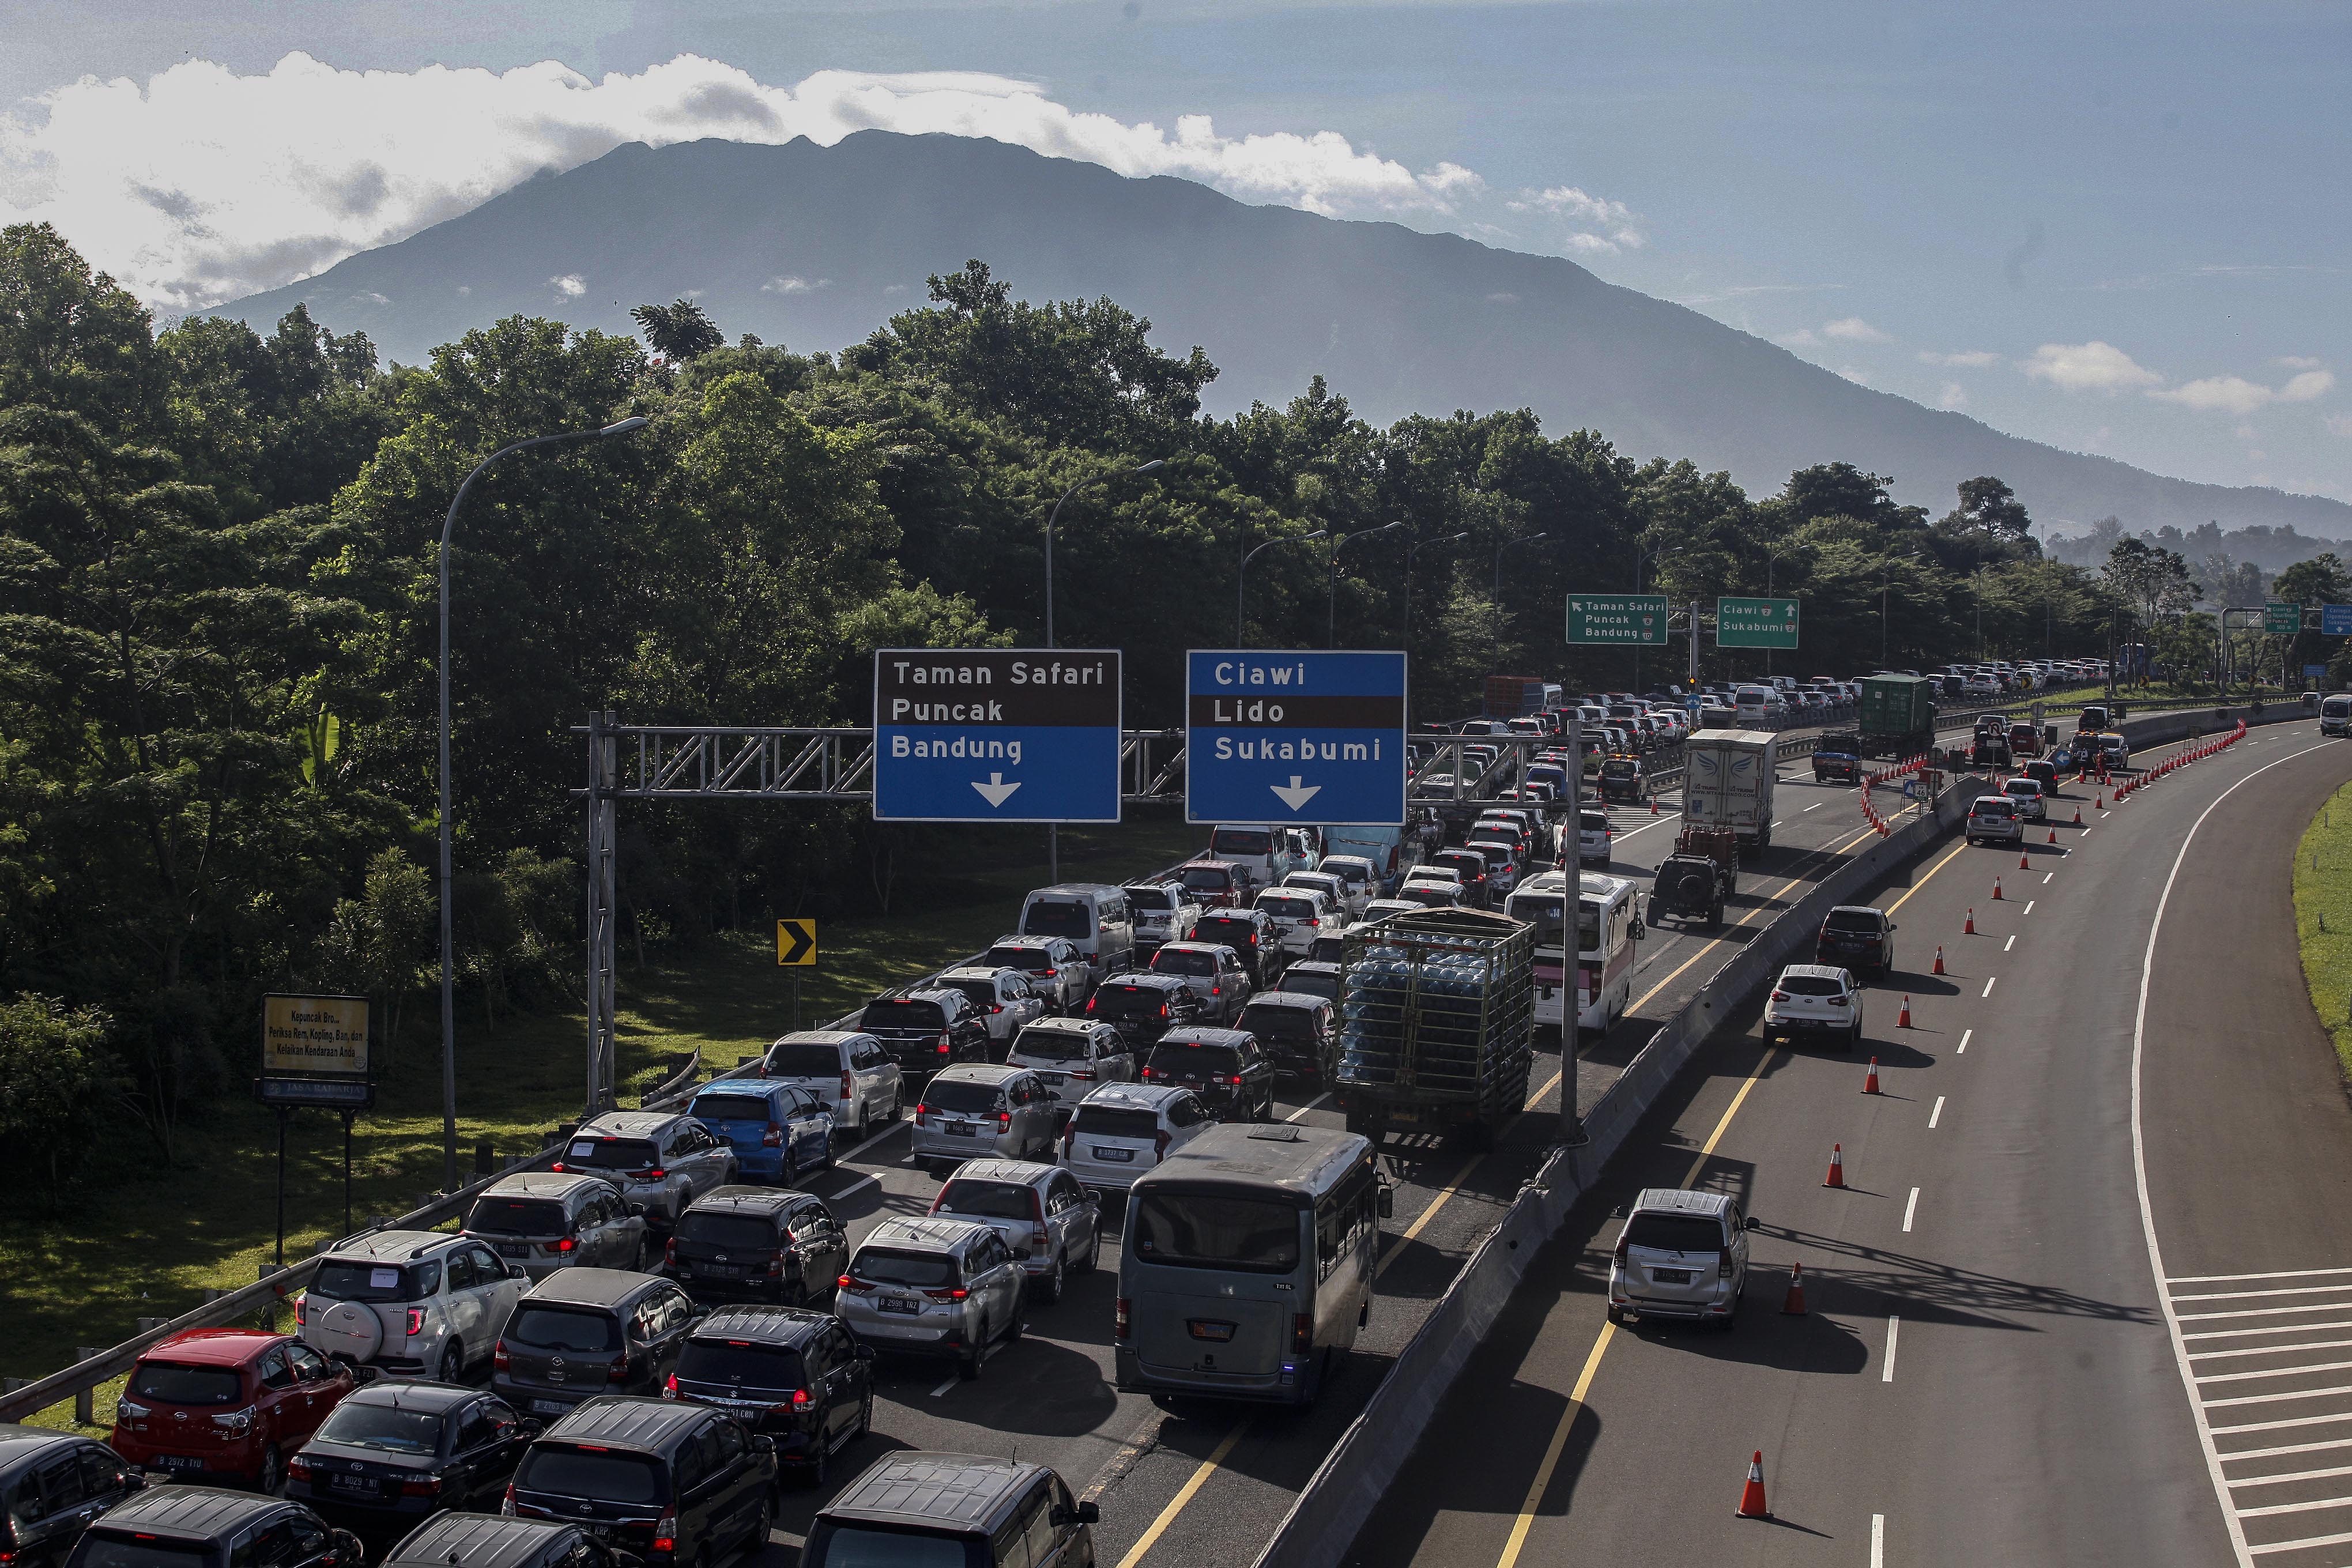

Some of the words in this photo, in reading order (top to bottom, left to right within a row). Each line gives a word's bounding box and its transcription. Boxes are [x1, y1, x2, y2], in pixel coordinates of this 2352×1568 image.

[1586, 601, 1624, 610] Taman
[1629, 602, 1664, 611] Safari
[1724, 605, 1757, 615] Ciawi
[1586, 615, 1629, 624] Puncak
[1724, 622, 1782, 632] Sukabumi
[1585, 628, 1637, 639] Bandung
[894, 662, 992, 684] Taman
[1010, 662, 1103, 684] Safari
[1215, 662, 1304, 685] Ciawi
[892, 698, 1002, 721] Puncak
[1215, 699, 1284, 722] Lido
[892, 735, 1022, 766] Bandung
[1215, 737, 1379, 760] Sukabumi
[1553, 908, 1560, 918] 14
[291, 1010, 322, 1025] Kepuncak
[269, 1026, 292, 1039] Periksa
[293, 1027, 308, 1042] Rem,
[310, 1028, 334, 1043] Kopling,
[336, 1030, 350, 1042] Ban,
[350, 1030, 363, 1042] dan
[277, 1043, 303, 1056] Kelaikan
[304, 1044, 338, 1057] Kendaraan
[339, 1046, 356, 1058] Anda
[287, 1083, 311, 1092] JASA
[314, 1085, 360, 1095] RAHARJA
[887, 1299, 903, 1307] 2988
[906, 1301, 917, 1309] TRZ
[544, 1402, 559, 1410] 2763
[160, 1456, 165, 1465] B
[168, 1457, 184, 1467] 2972
[189, 1458, 202, 1468] TYU
[334, 1473, 339, 1483] B
[344, 1475, 363, 1486] 8029
[368, 1479, 378, 1488] NY
[594, 1525, 609, 1536] KRP
